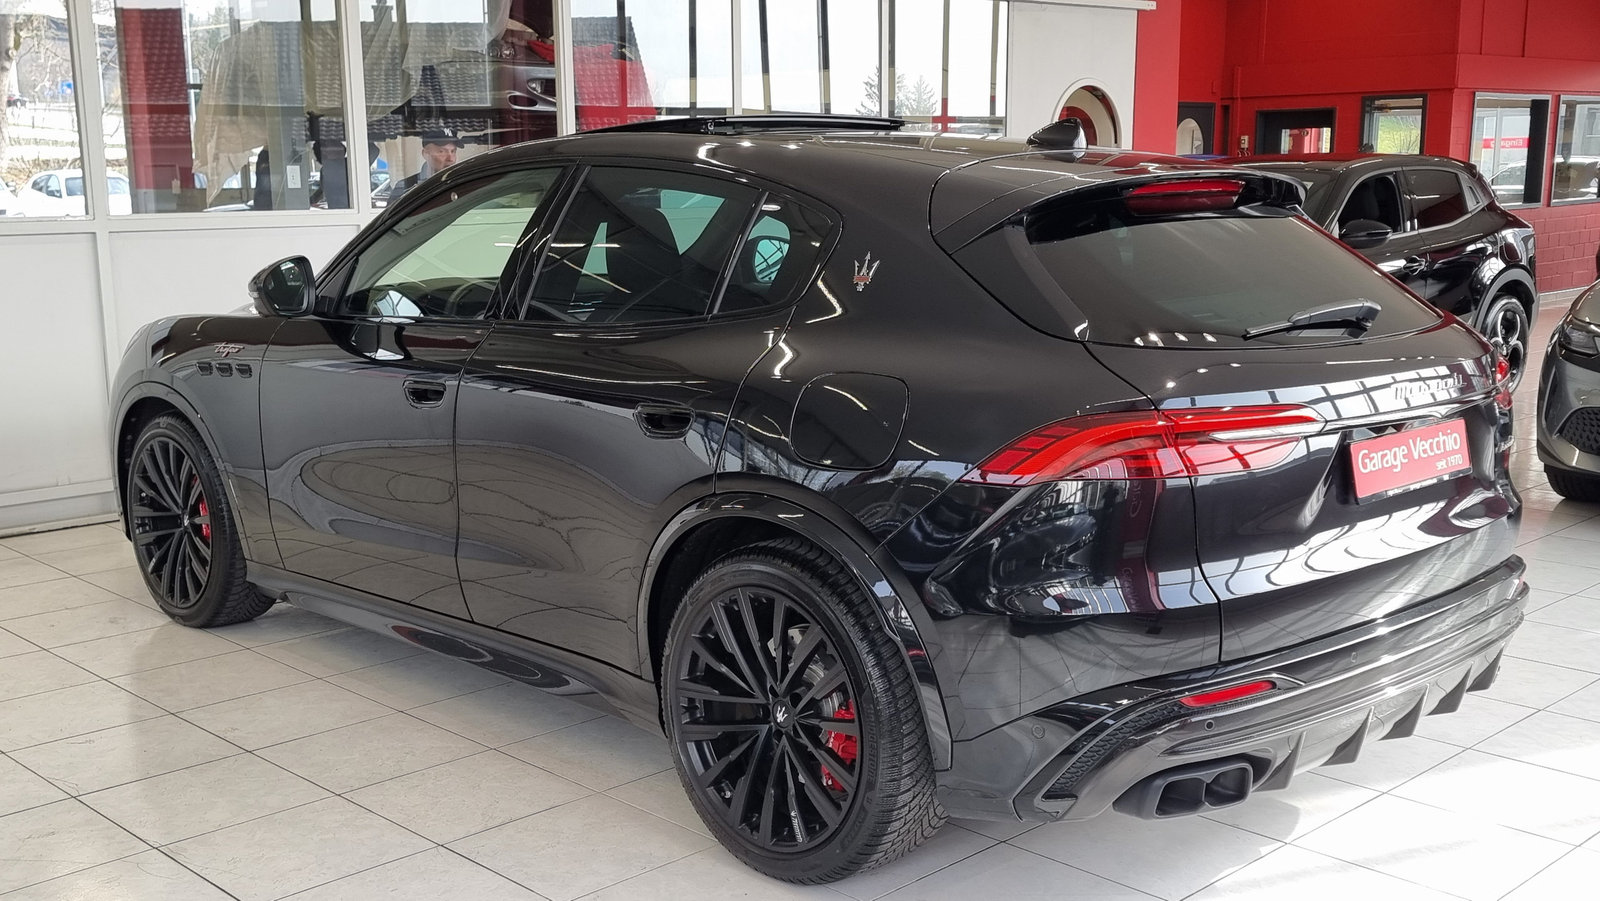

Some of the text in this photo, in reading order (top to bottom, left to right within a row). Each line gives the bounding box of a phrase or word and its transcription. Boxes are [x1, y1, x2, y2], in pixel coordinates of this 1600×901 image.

[1358, 445, 1408, 472] Garage
[1409, 430, 1461, 460] Vecchio
[1448, 454, 1463, 467] 1970
